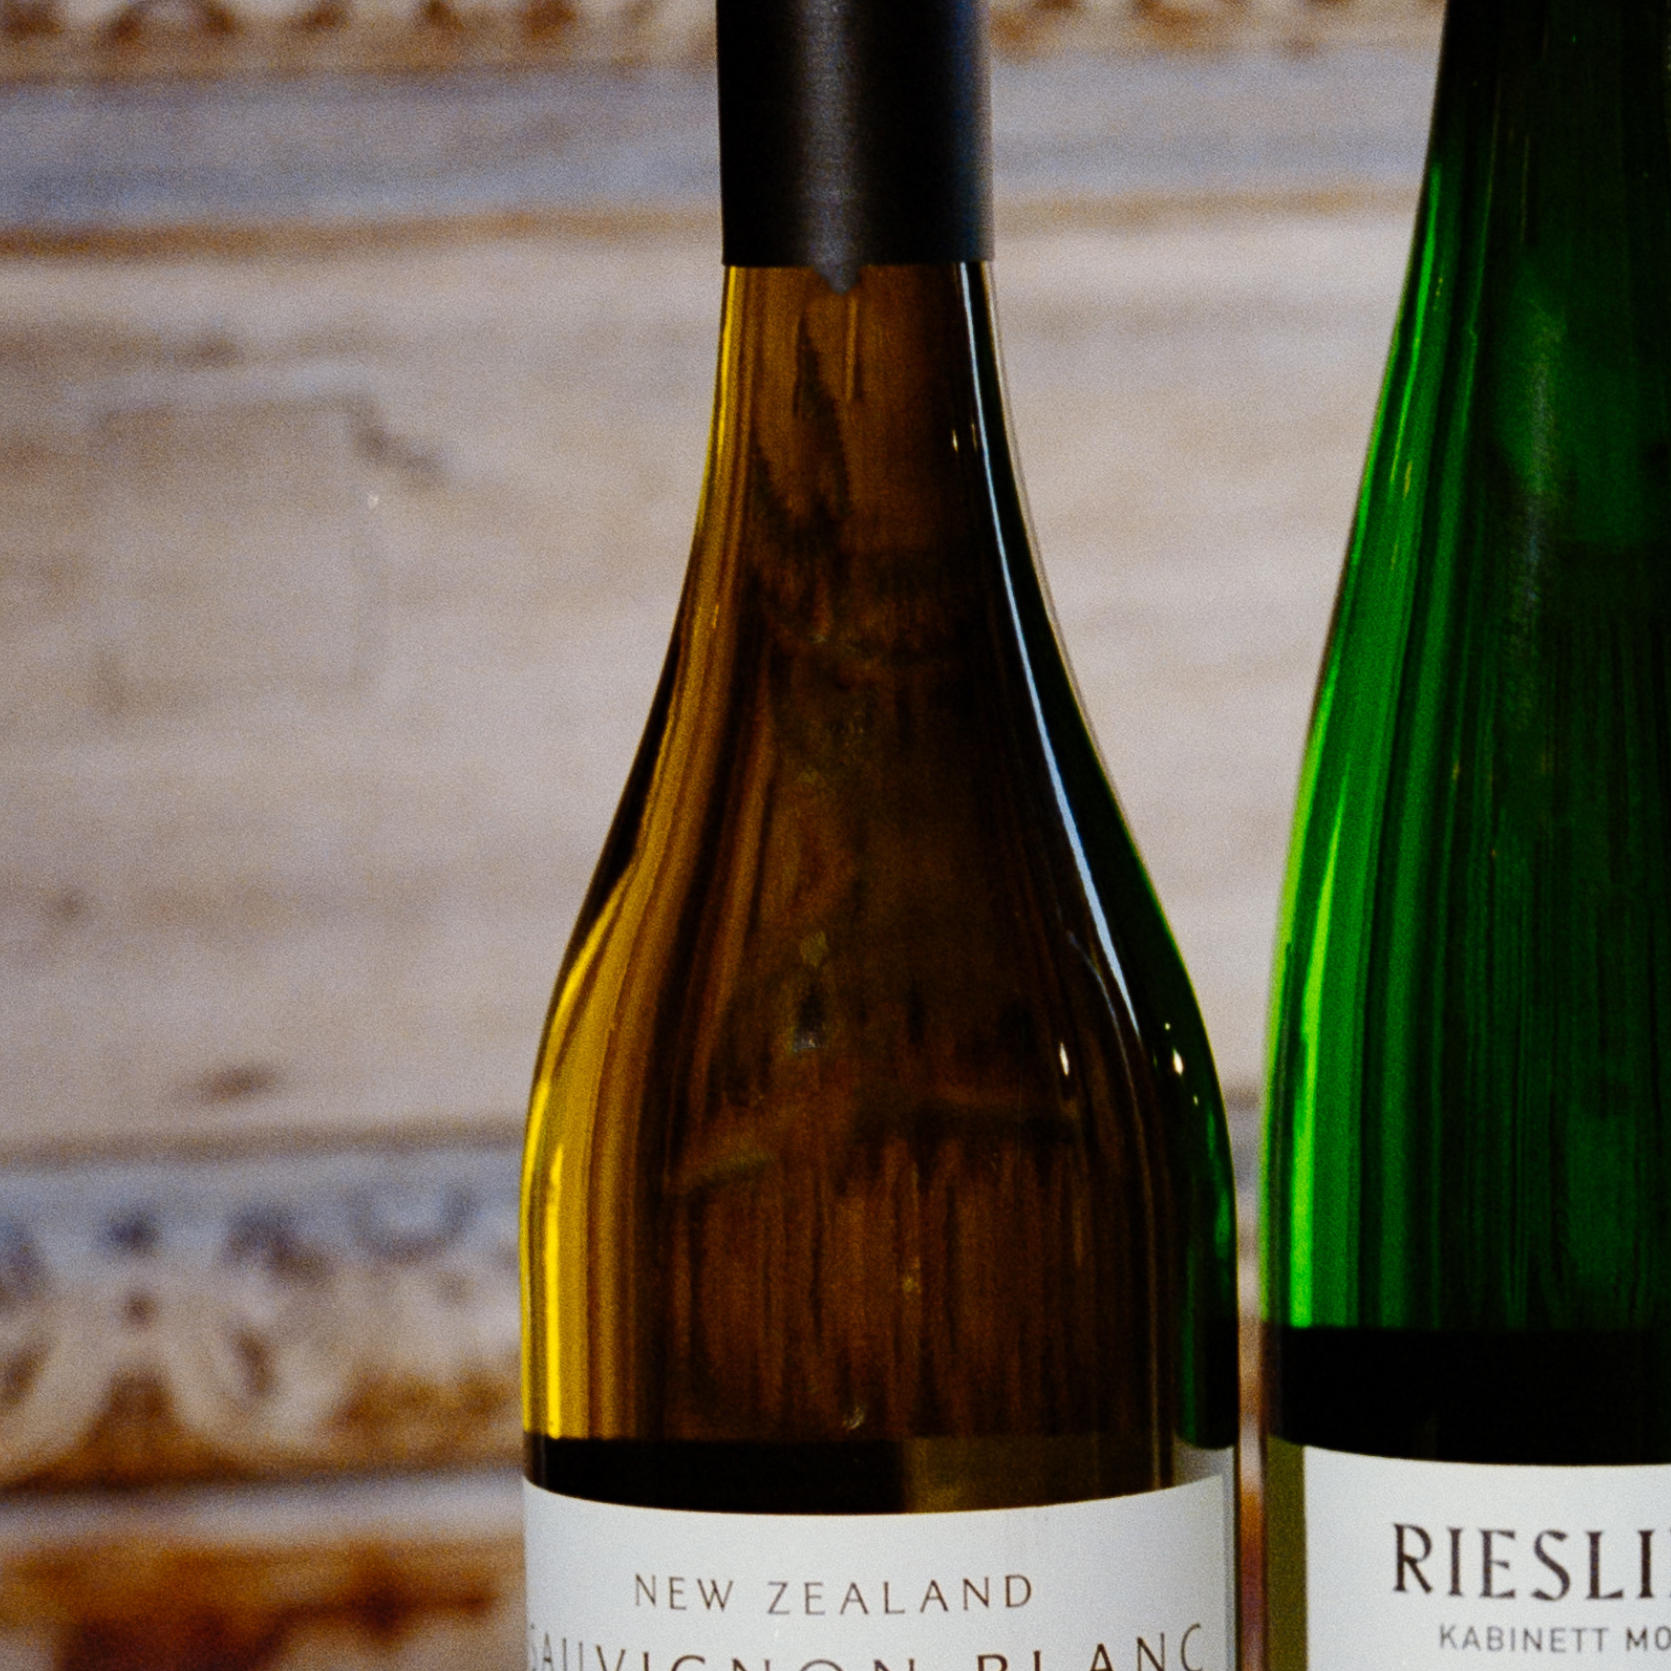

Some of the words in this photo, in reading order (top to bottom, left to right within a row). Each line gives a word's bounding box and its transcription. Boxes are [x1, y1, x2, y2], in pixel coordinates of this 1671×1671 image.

[634, 1572, 735, 1613] NEW
[766, 1573, 1033, 1617] ZEALAND
[1438, 1623, 1610, 1655] KABINETT
